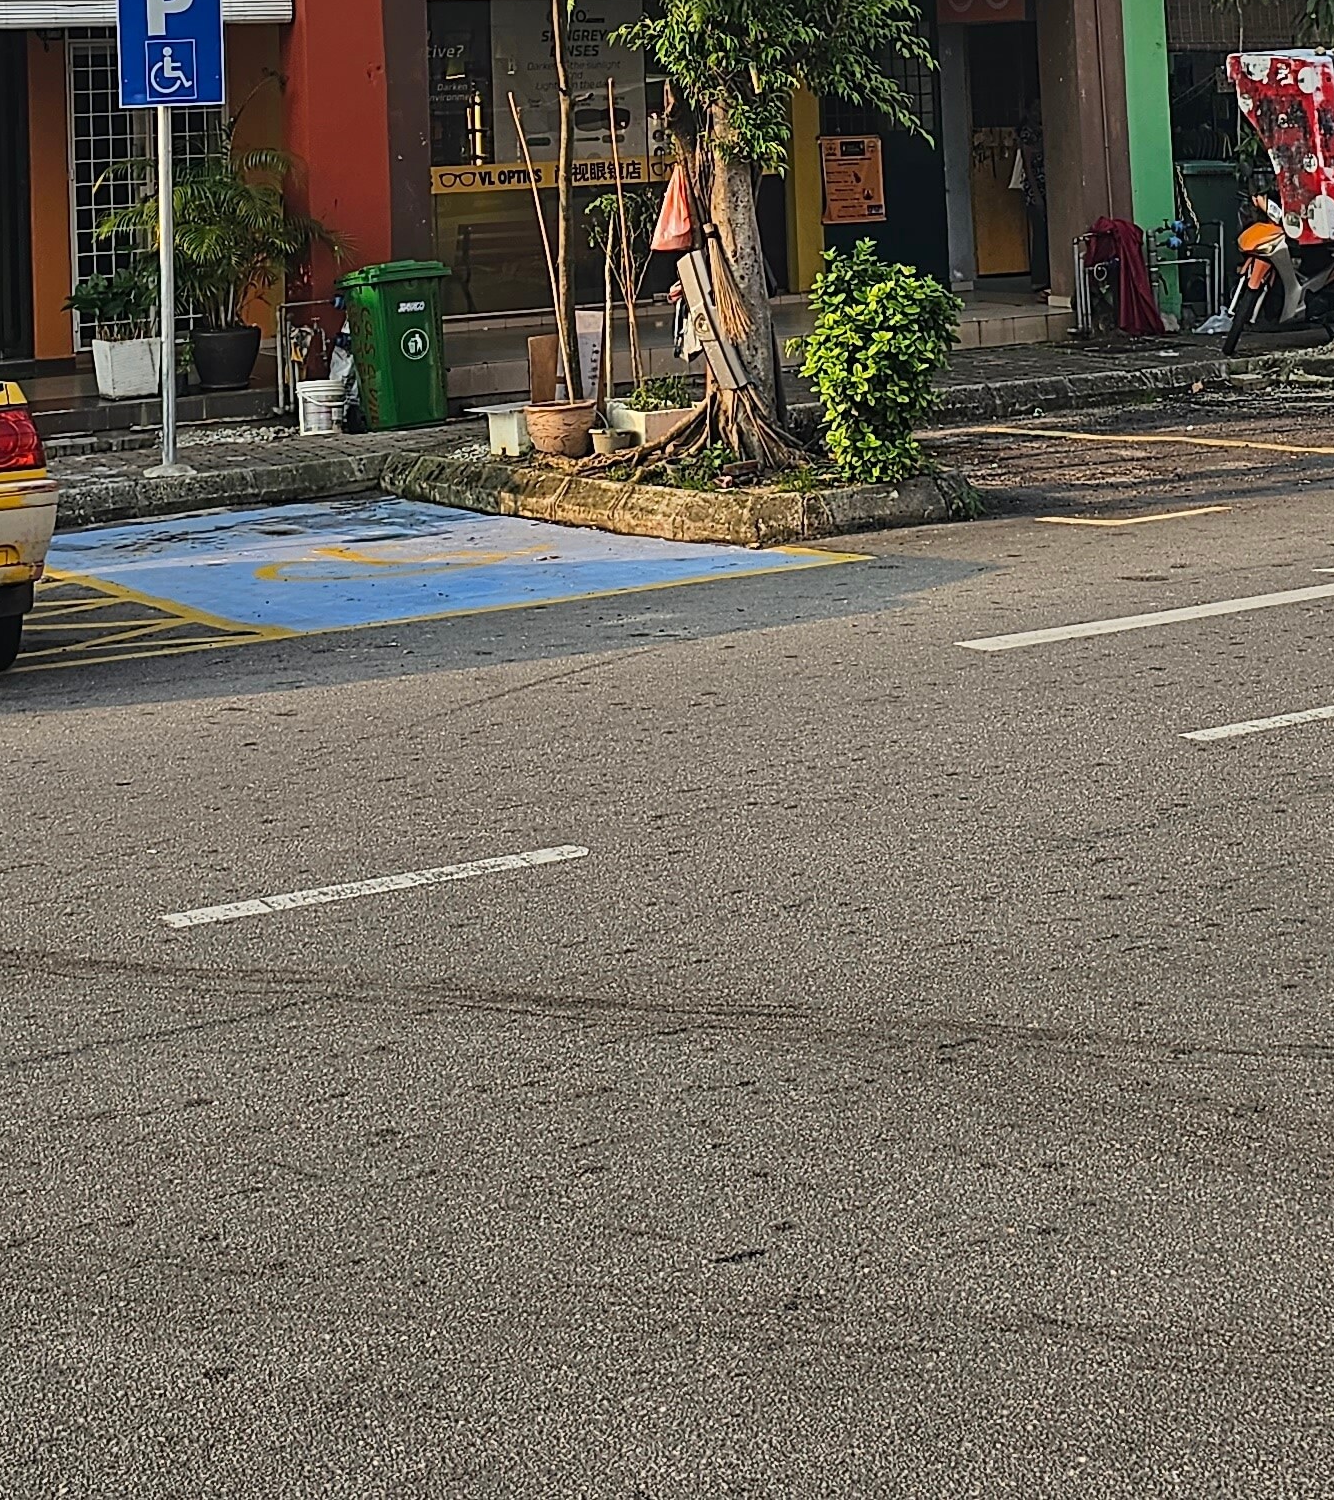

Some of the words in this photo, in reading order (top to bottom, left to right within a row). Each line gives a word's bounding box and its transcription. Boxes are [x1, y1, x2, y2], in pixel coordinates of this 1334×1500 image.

[427, 44, 465, 59] tive?
[549, 44, 600, 57] LNSES
[478, 170, 496, 187] VL
[554, 160, 642, 184] 视眼镜店
